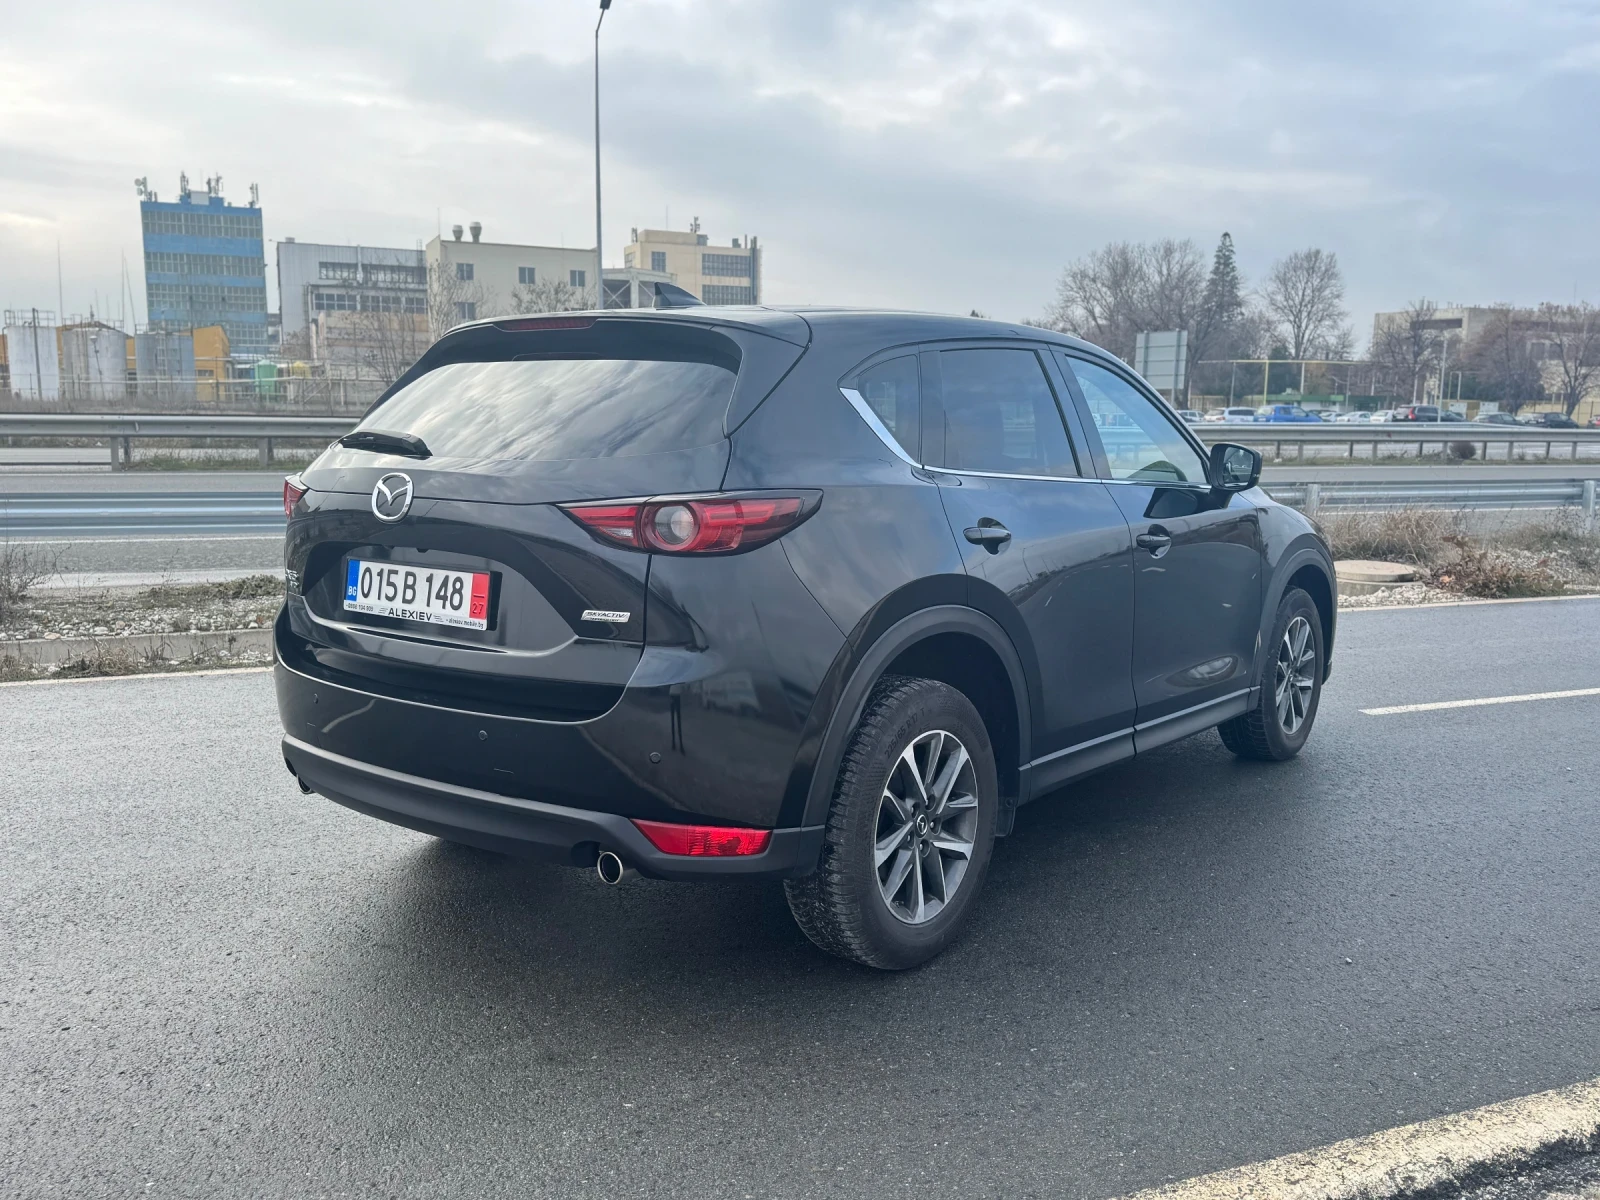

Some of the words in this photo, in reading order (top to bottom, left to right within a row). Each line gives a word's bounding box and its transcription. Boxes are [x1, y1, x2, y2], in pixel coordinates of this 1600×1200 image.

[348, 585, 357, 596] BG
[388, 608, 432, 621] ALEXIEV
[472, 603, 484, 615] 27
